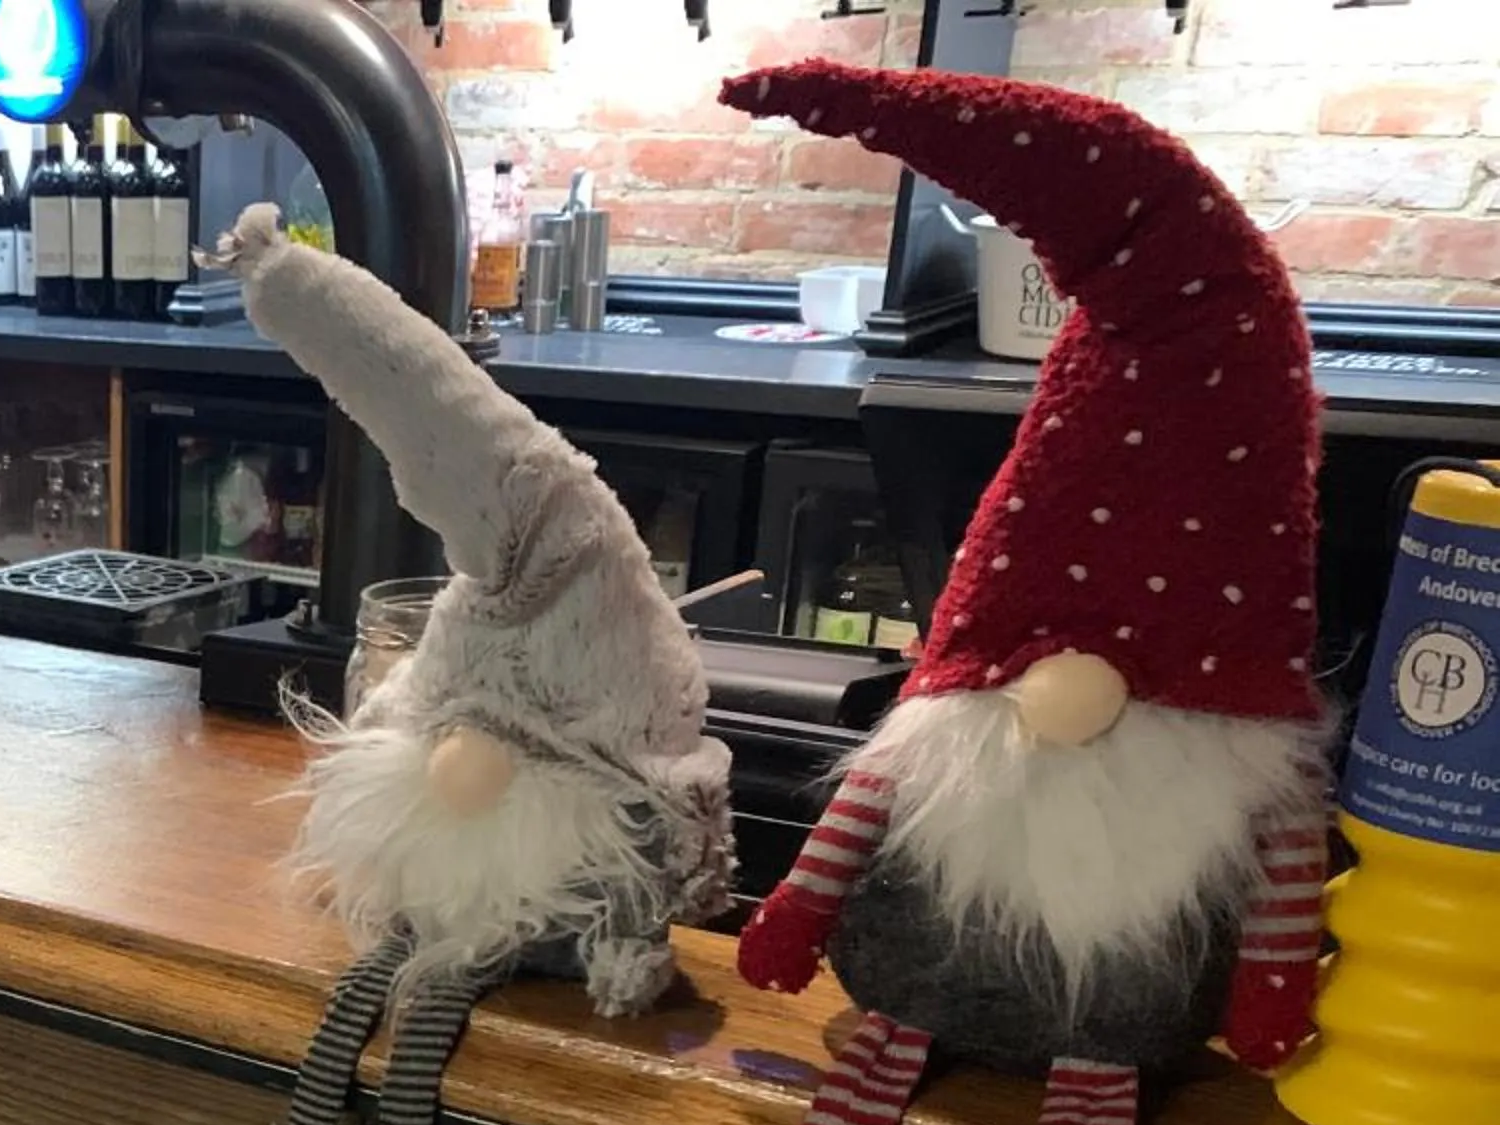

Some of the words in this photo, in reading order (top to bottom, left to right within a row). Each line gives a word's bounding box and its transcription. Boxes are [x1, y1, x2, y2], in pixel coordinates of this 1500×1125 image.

[1022, 284, 1058, 304] MO
[1019, 304, 1069, 328] CID
[1430, 543, 1453, 564] of
[1390, 758, 1429, 779] care
[1433, 763, 1466, 785] for
